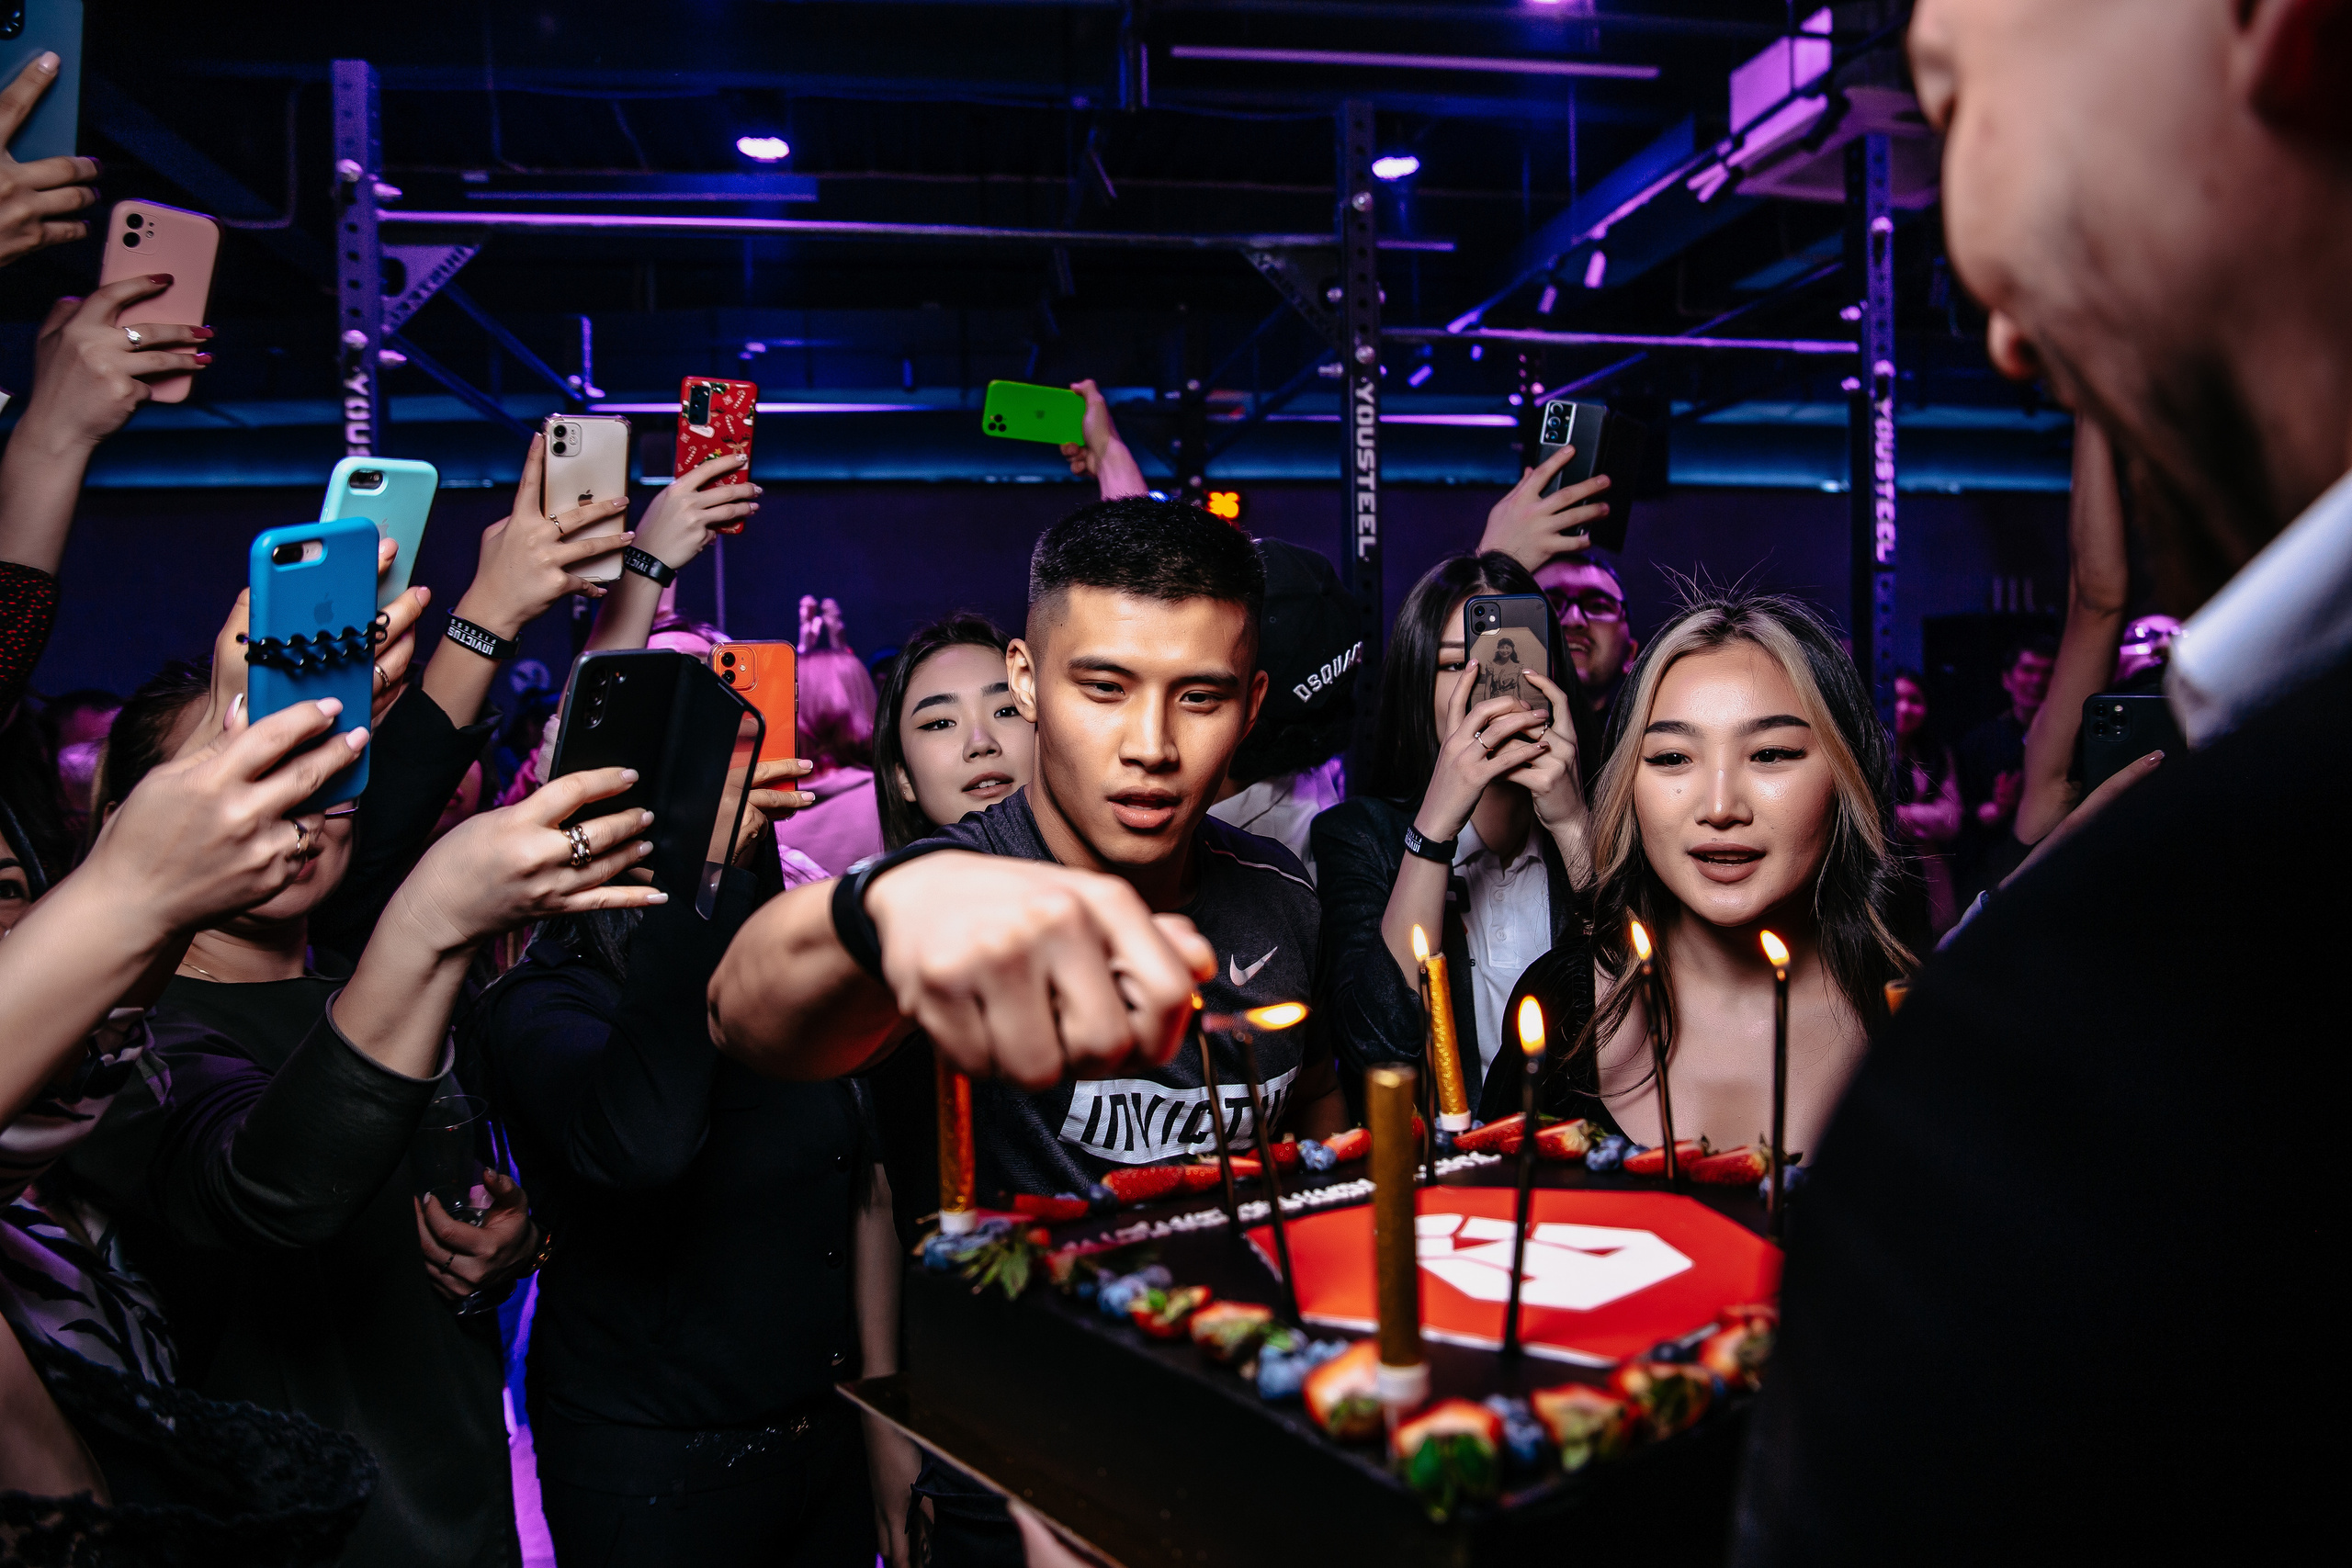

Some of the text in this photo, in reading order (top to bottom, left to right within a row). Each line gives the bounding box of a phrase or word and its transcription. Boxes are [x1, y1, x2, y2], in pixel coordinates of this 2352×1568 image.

[1355, 382, 1376, 558] YOUSTEEL
[1875, 396, 1895, 563] YOUSTEEL
[447, 626, 494, 655] INVICTUS
[1080, 1088, 1294, 1152] INVICTU
